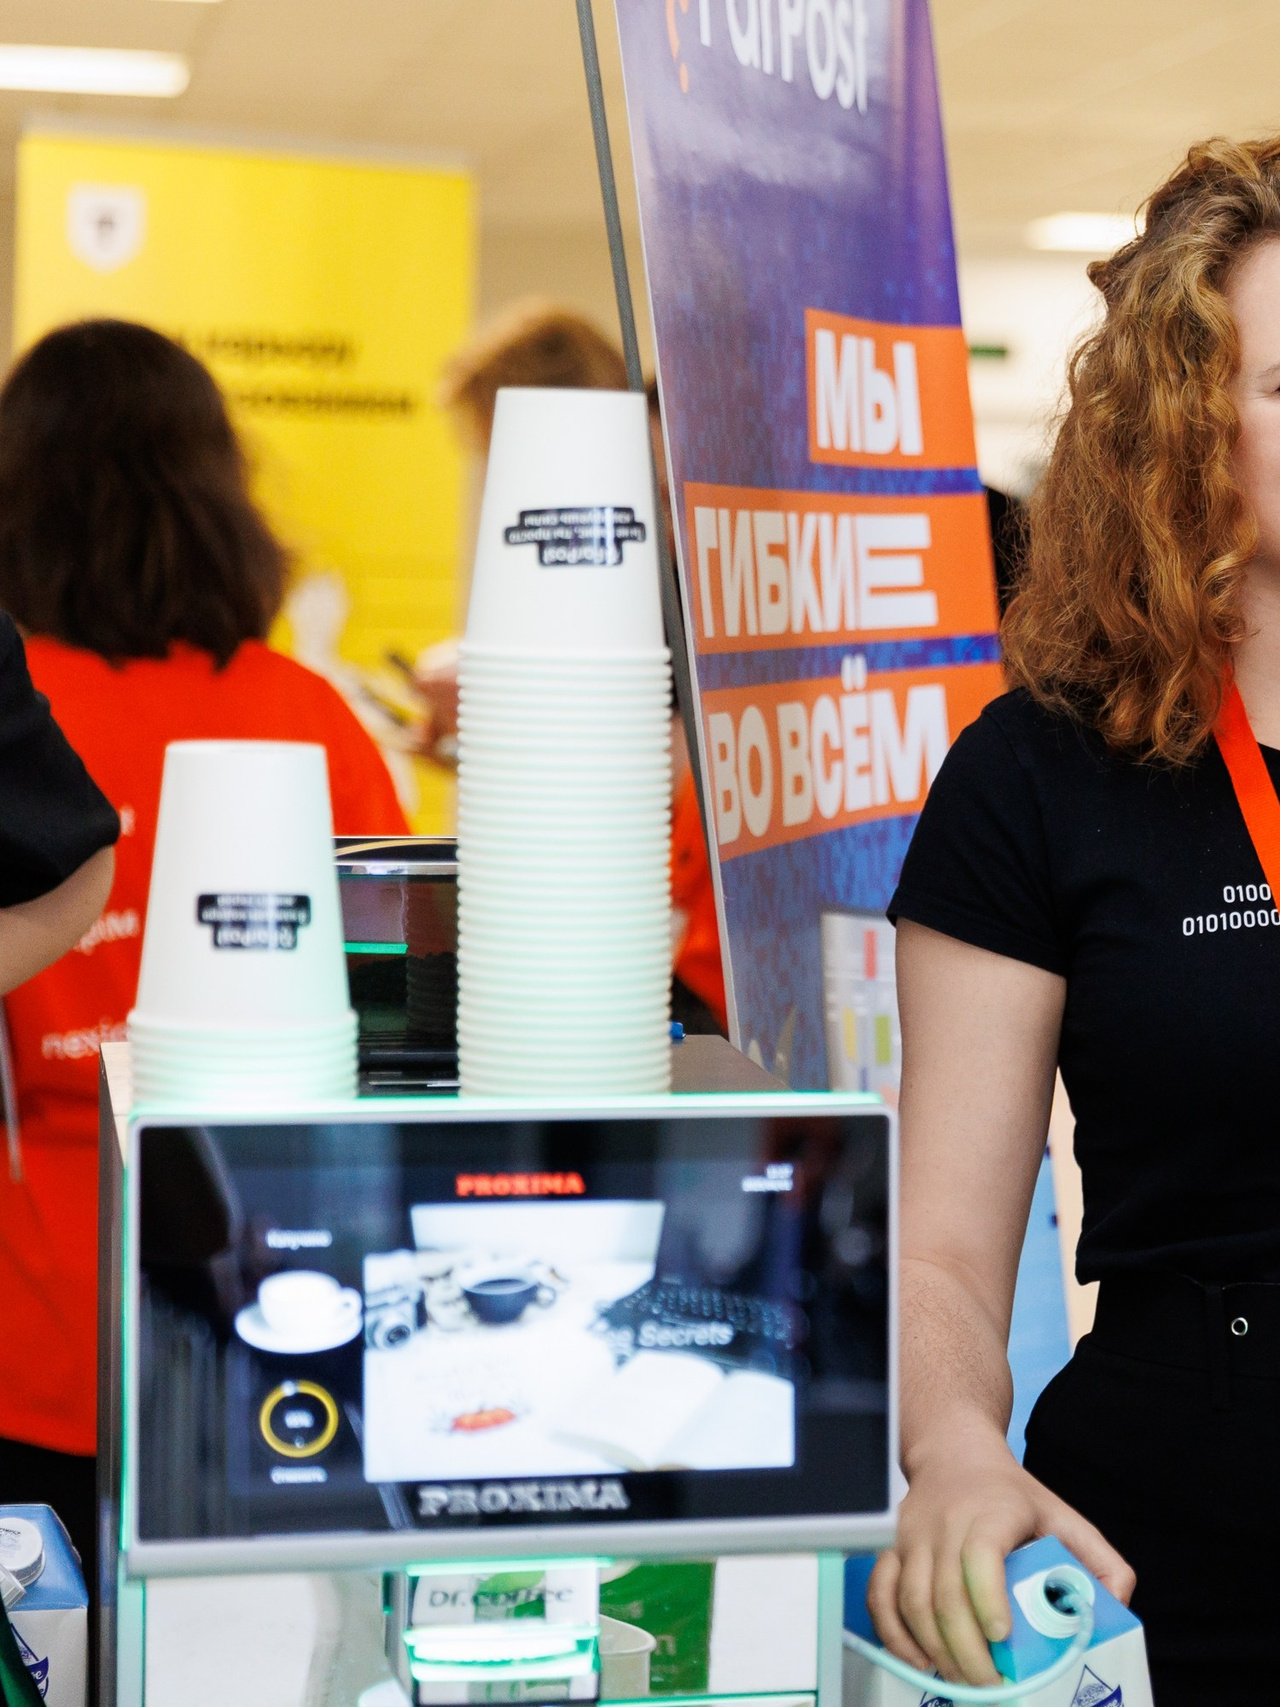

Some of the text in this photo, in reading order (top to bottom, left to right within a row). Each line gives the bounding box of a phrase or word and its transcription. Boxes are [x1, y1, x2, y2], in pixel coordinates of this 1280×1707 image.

[814, 328, 923, 457] МЫ
[694, 506, 938, 639] ГИБКИЕ
[707, 653, 949, 847] ВО ВСЁМ
[456, 1172, 586, 1197] PROXIMA
[418, 1478, 631, 1517] PROXIMA
